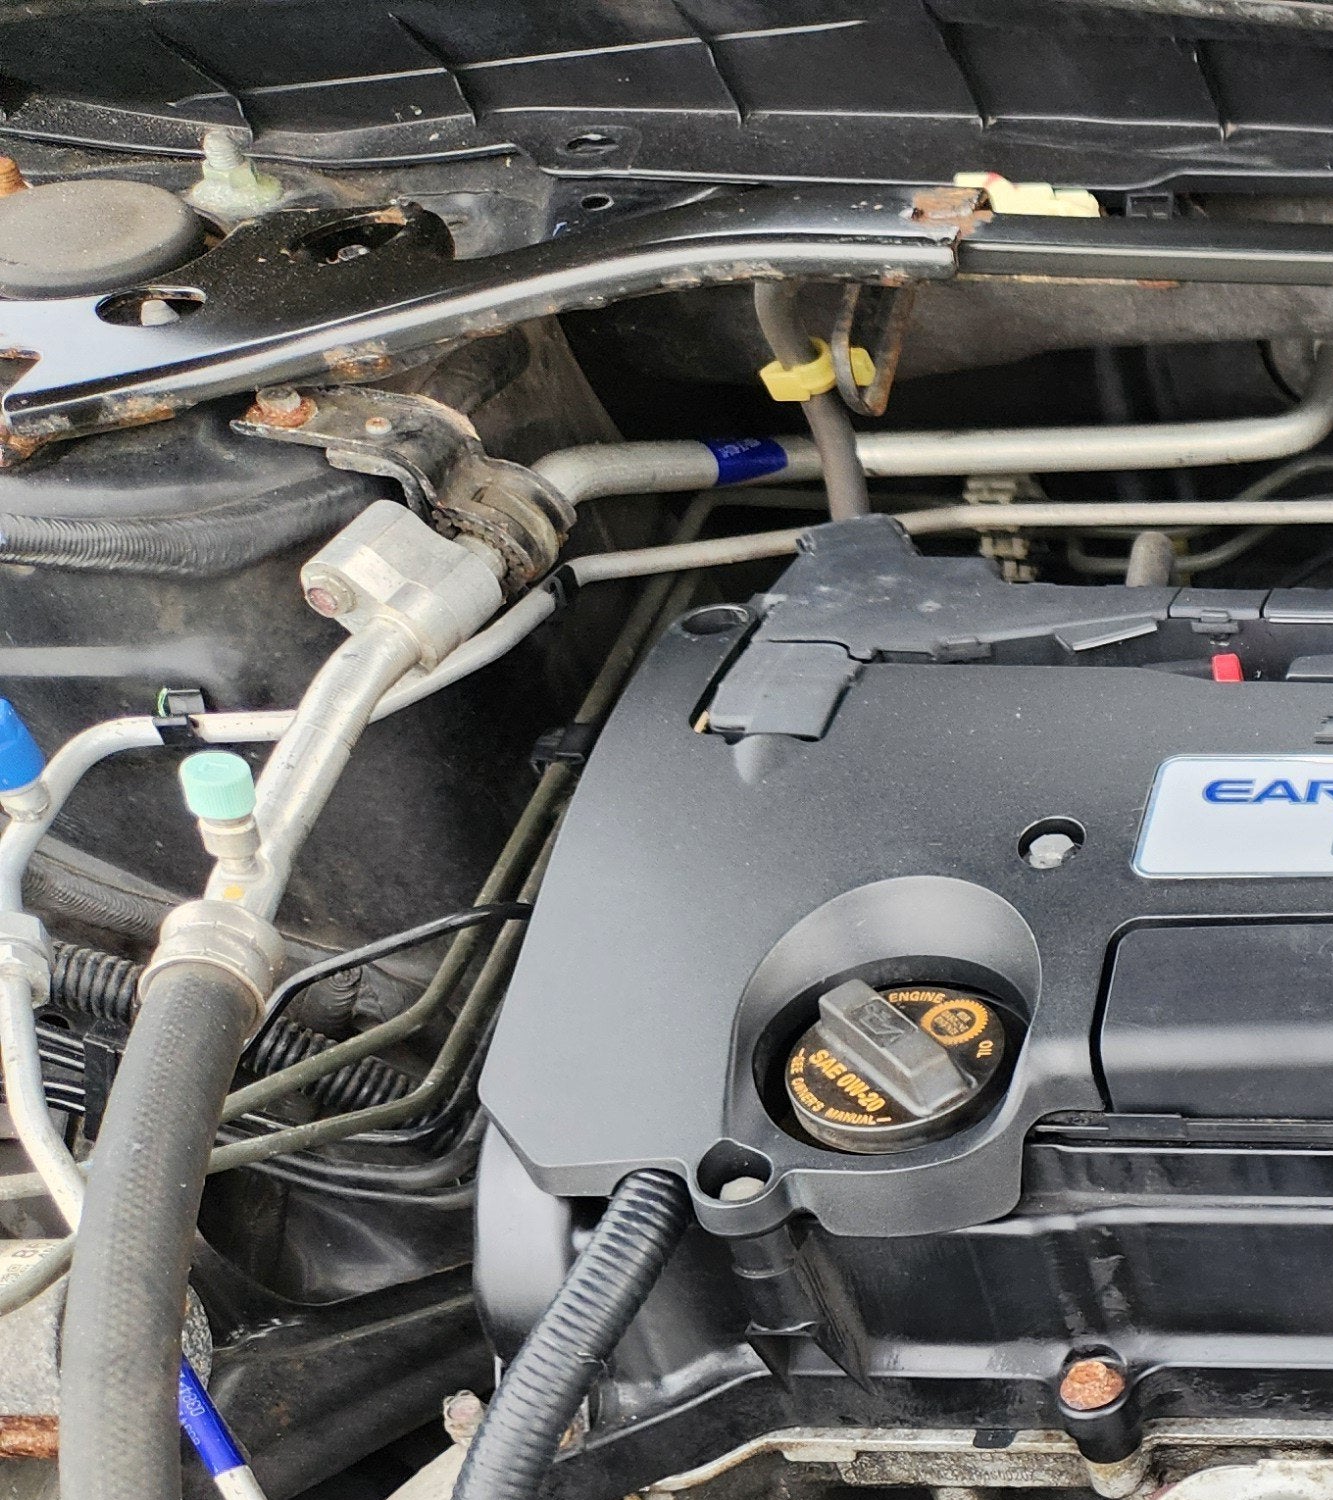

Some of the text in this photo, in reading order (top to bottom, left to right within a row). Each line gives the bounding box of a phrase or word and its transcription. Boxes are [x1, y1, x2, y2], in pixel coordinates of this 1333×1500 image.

[889, 991, 994, 1059] ENGINE OIL
[809, 1049, 886, 1112] SAE 0W-20
